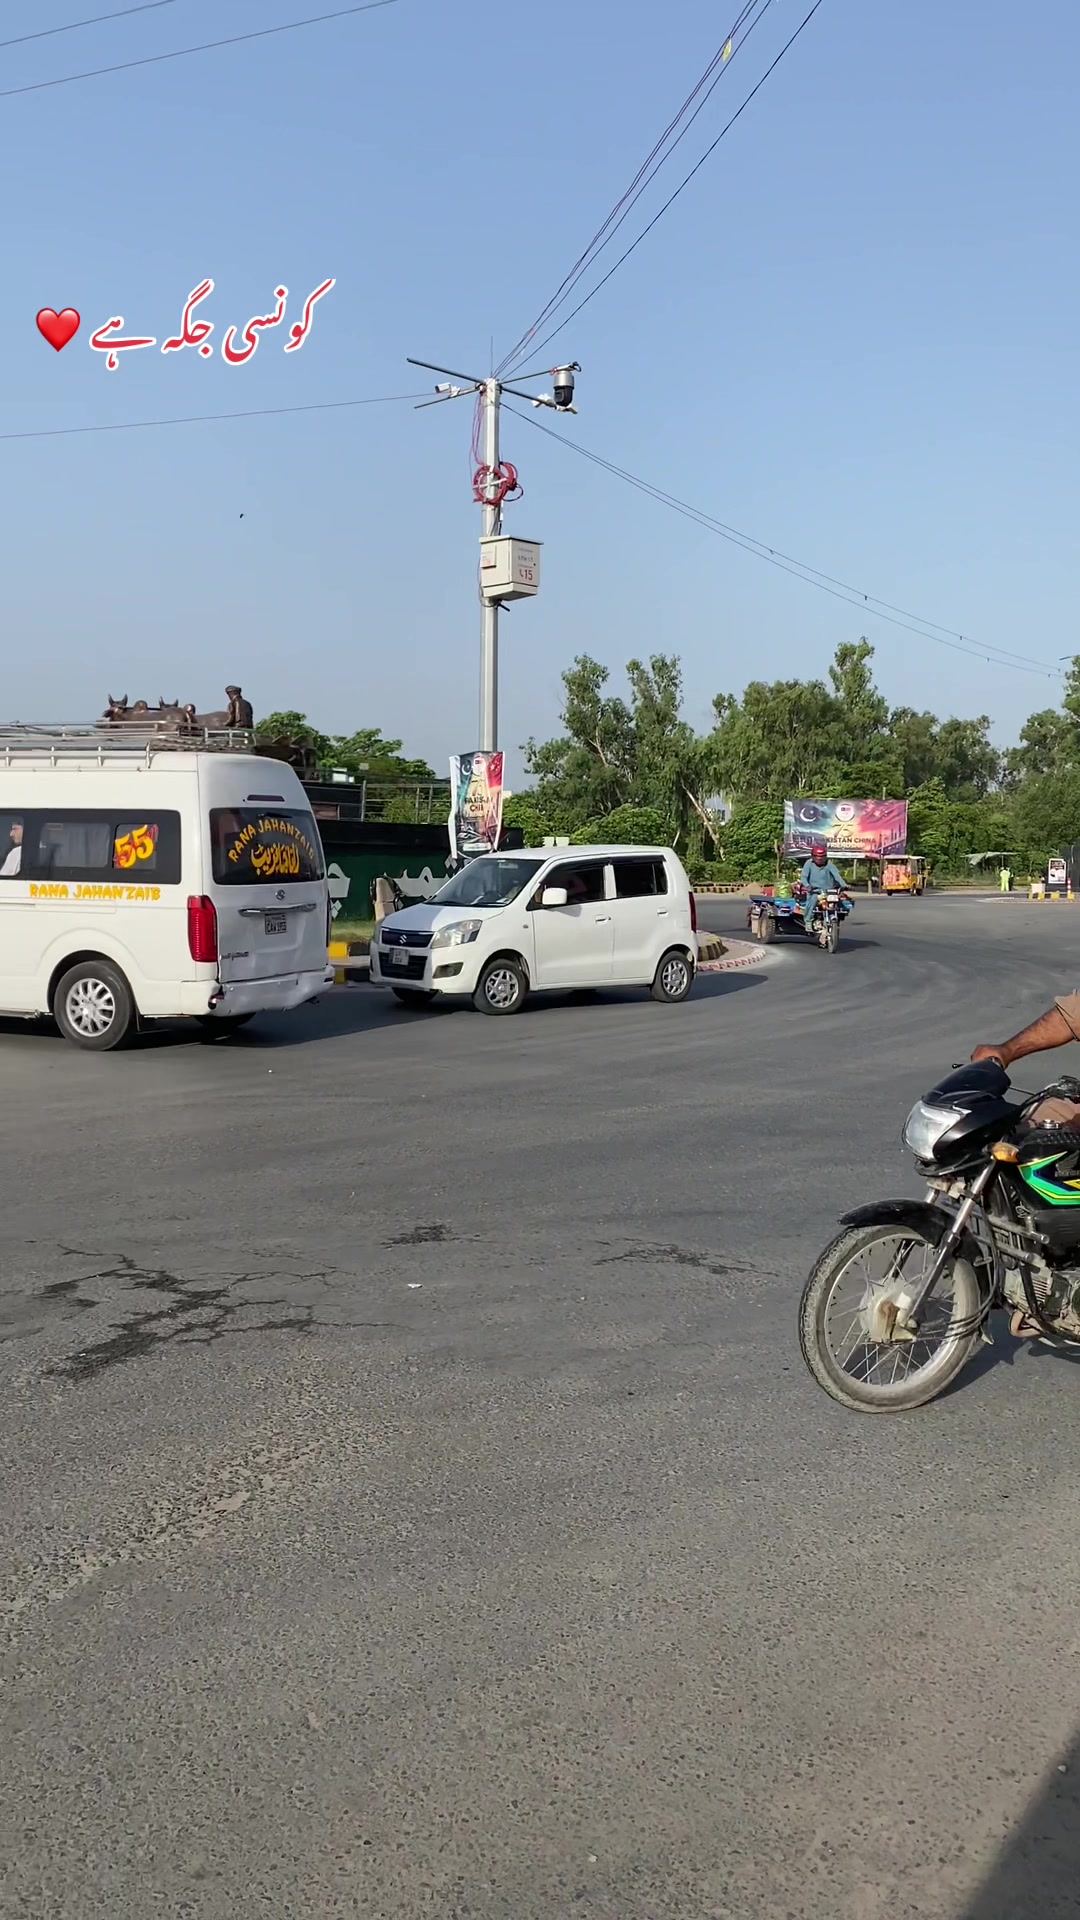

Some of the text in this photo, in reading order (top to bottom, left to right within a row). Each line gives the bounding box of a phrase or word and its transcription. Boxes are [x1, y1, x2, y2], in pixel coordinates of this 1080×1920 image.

[525, 569, 533, 581] 15
[832, 824, 853, 838] 75
[115, 824, 154, 869] 55
[228, 824, 257, 863] RANA
[29, 883, 161, 900] RANA JAHANZAIB
